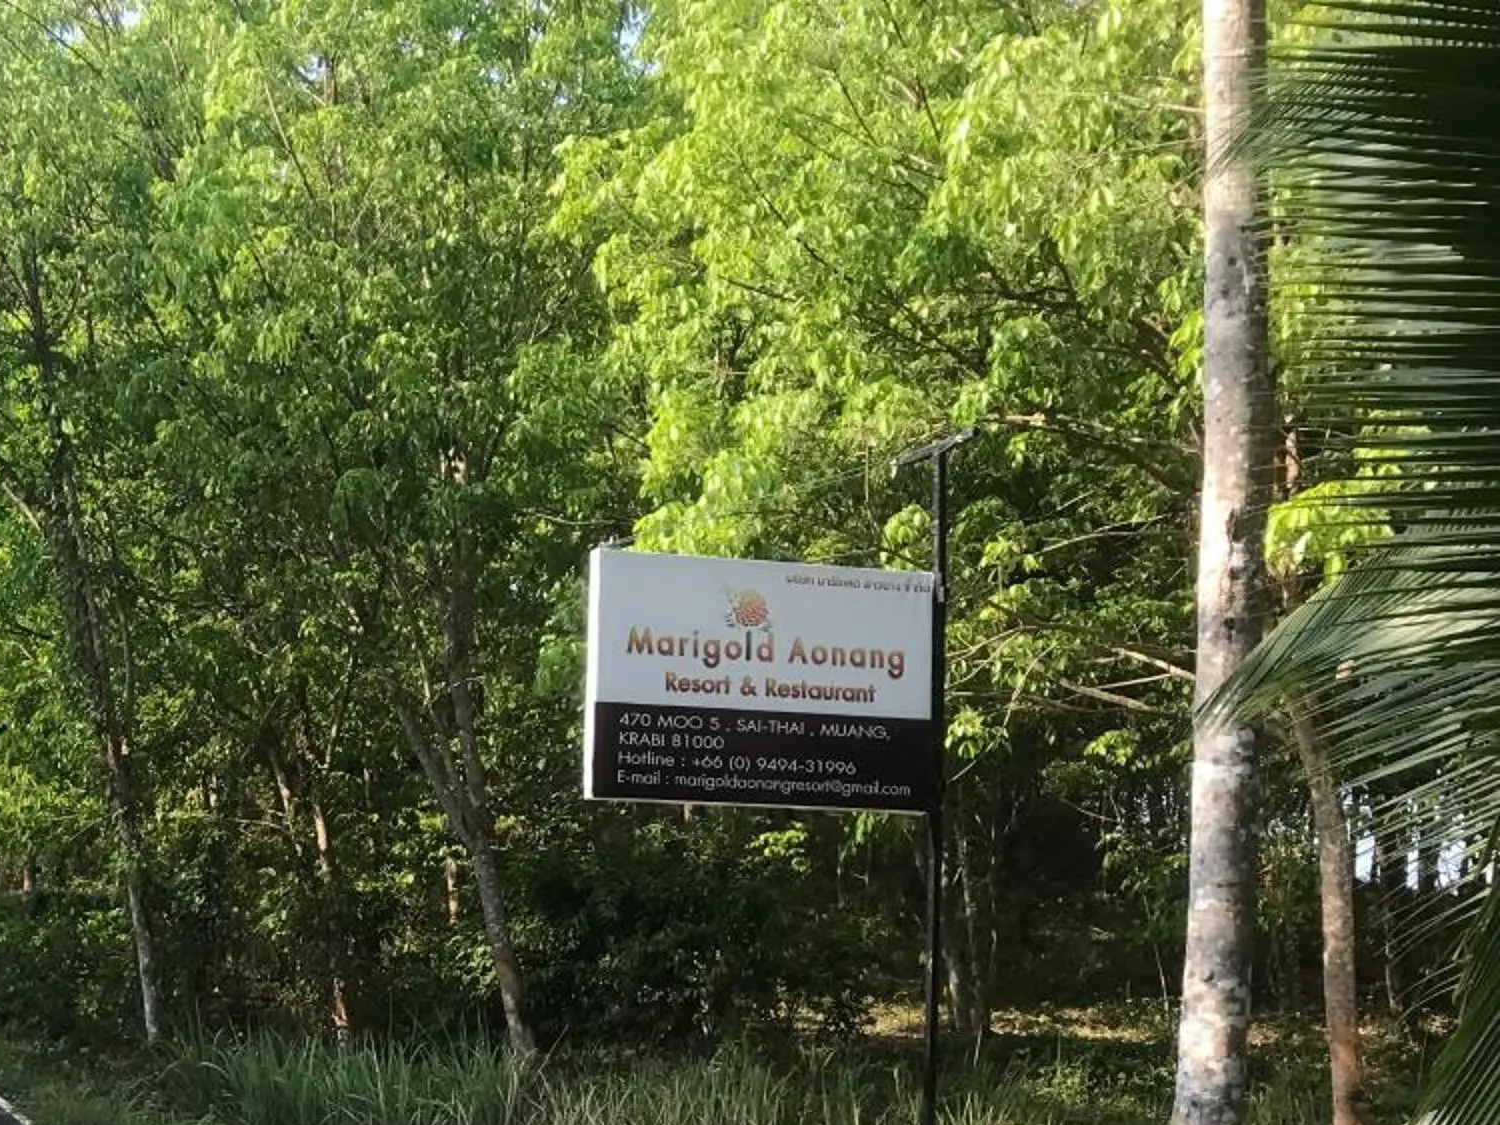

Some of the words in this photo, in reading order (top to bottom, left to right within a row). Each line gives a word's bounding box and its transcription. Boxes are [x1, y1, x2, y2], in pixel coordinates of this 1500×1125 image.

[626, 626, 775, 668] Marigold
[788, 637, 906, 679] Aonang
[665, 672, 730, 695] Resort
[740, 676, 757, 696] &
[765, 677, 877, 702] Restaurant
[619, 713, 652, 727] 470
[657, 715, 703, 729] MOO
[709, 717, 721, 731] 5
[736, 719, 805, 735] SAI-THAI
[619, 731, 665, 747] KRABI
[671, 733, 725, 750] 81000
[617, 750, 675, 767] Hotline
[693, 756, 723, 768] +66
[729, 755, 751, 771] (0)
[756, 757, 857, 775] 9494-31996
[617, 769, 660, 785] E-mail
